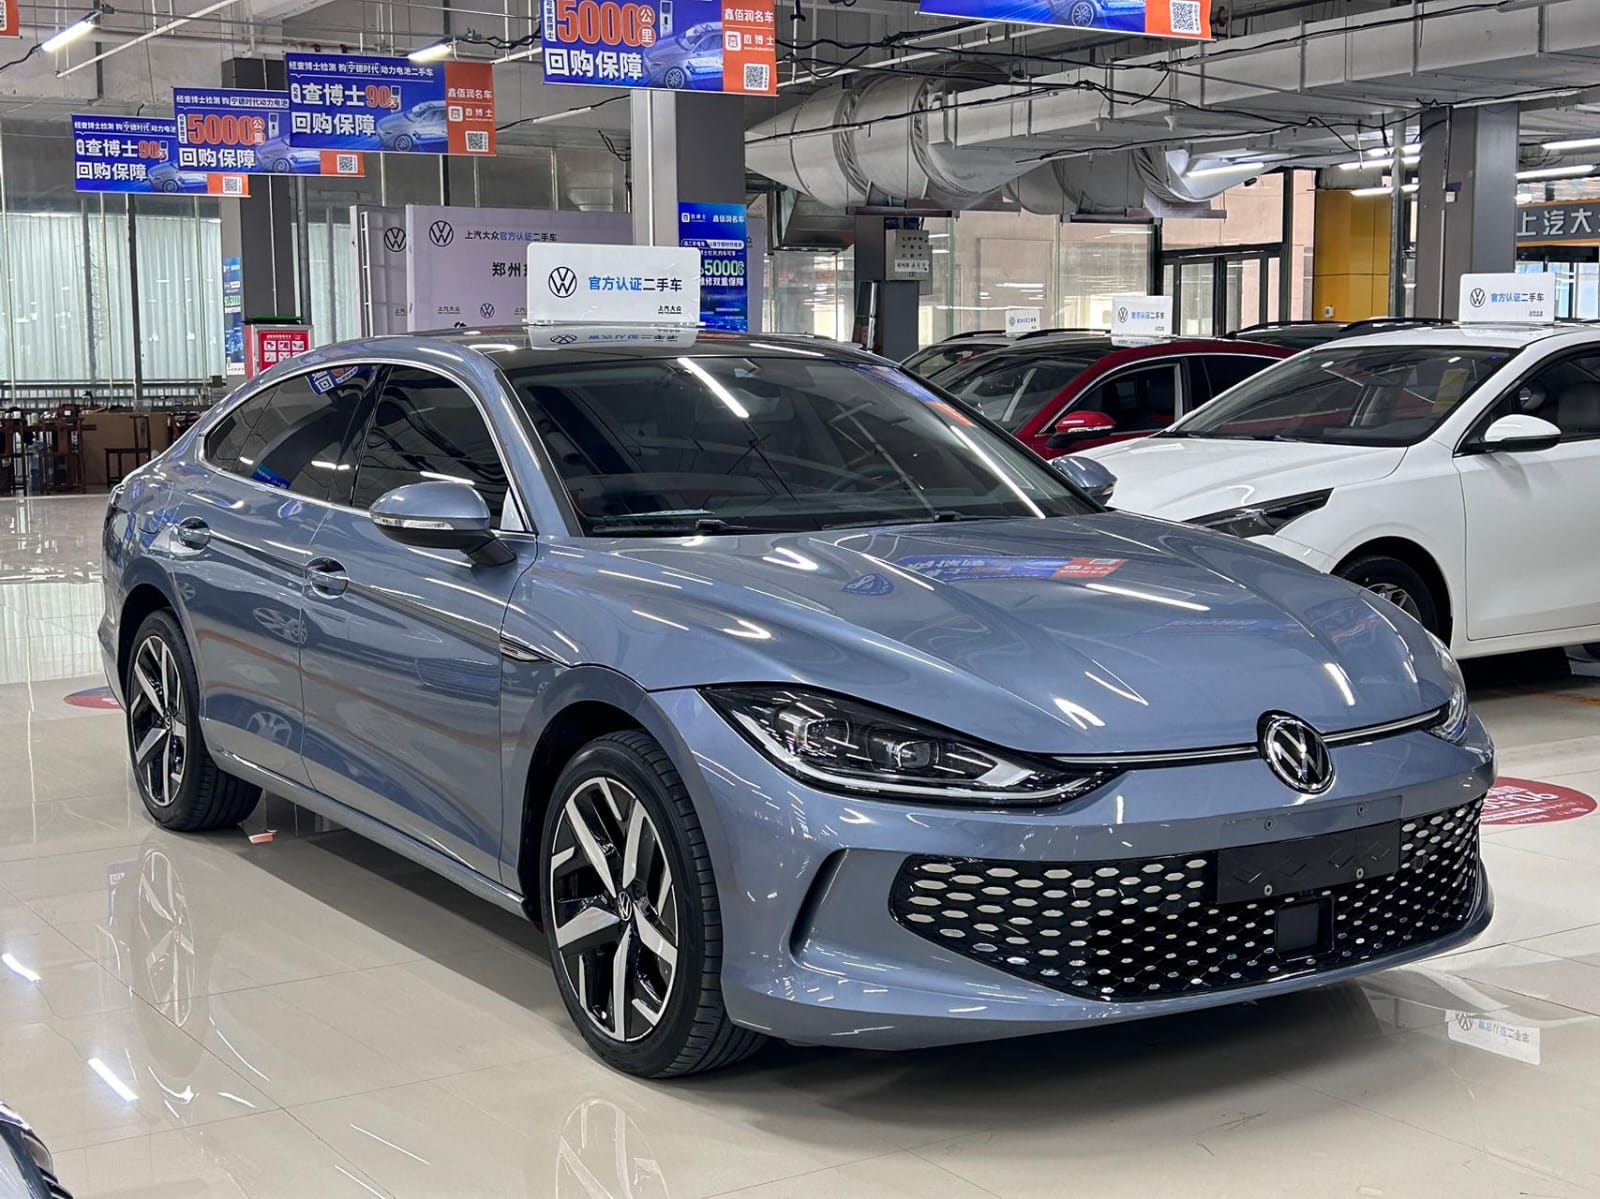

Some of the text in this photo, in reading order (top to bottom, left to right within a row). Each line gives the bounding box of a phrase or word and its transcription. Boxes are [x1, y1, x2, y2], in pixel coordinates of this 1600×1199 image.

[556, 0, 656, 47] 5000公里
[724, 8, 774, 23] 鑫佰润名车
[545, 47, 642, 80] 回购保障
[291, 111, 376, 136] 回购保障
[179, 147, 255, 169] 回购保障
[76, 161, 147, 181] 回购保障
[1516, 207, 1600, 236] 上汽大
[465, 230, 557, 241] 上汽大众官方认证二手车
[548, 266, 577, 298] VW
[588, 276, 682, 292] 官方认证二手车
[1491, 293, 1544, 302] 官方认证二手车
